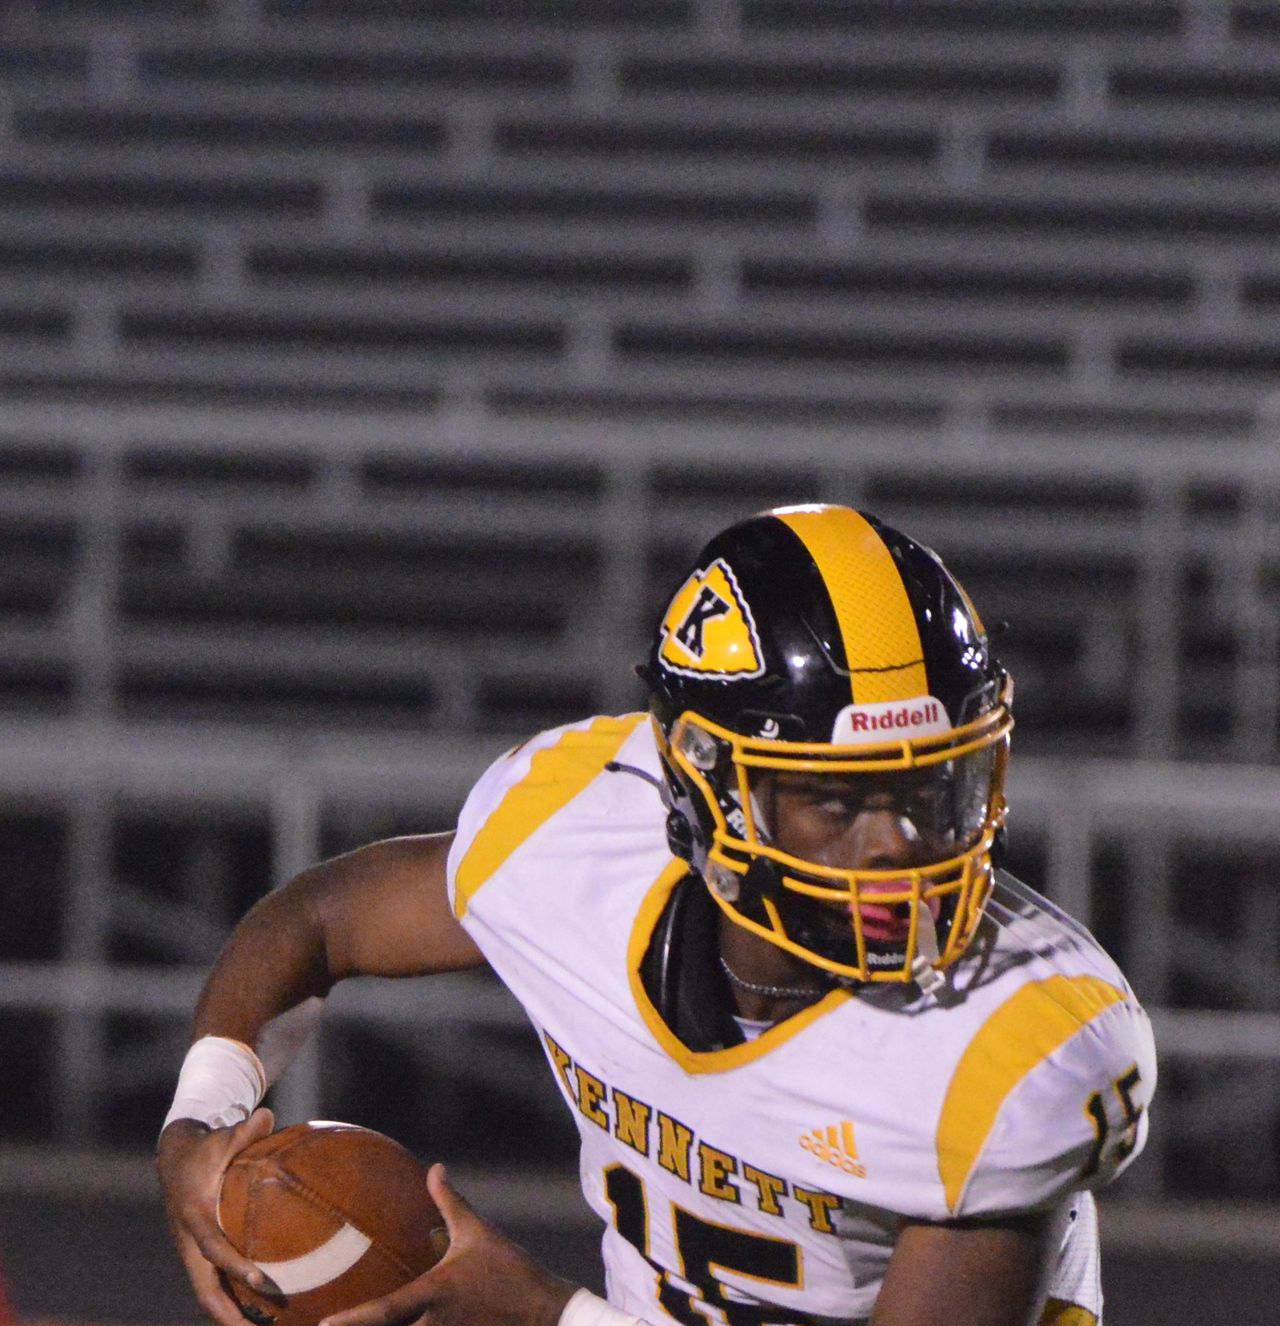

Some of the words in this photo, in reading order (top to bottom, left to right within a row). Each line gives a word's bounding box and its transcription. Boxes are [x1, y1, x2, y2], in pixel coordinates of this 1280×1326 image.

[673, 584, 731, 661] K
[850, 702, 939, 732] Riddell
[1083, 1060, 1144, 1177] 15
[799, 1134, 867, 1179] adidas
